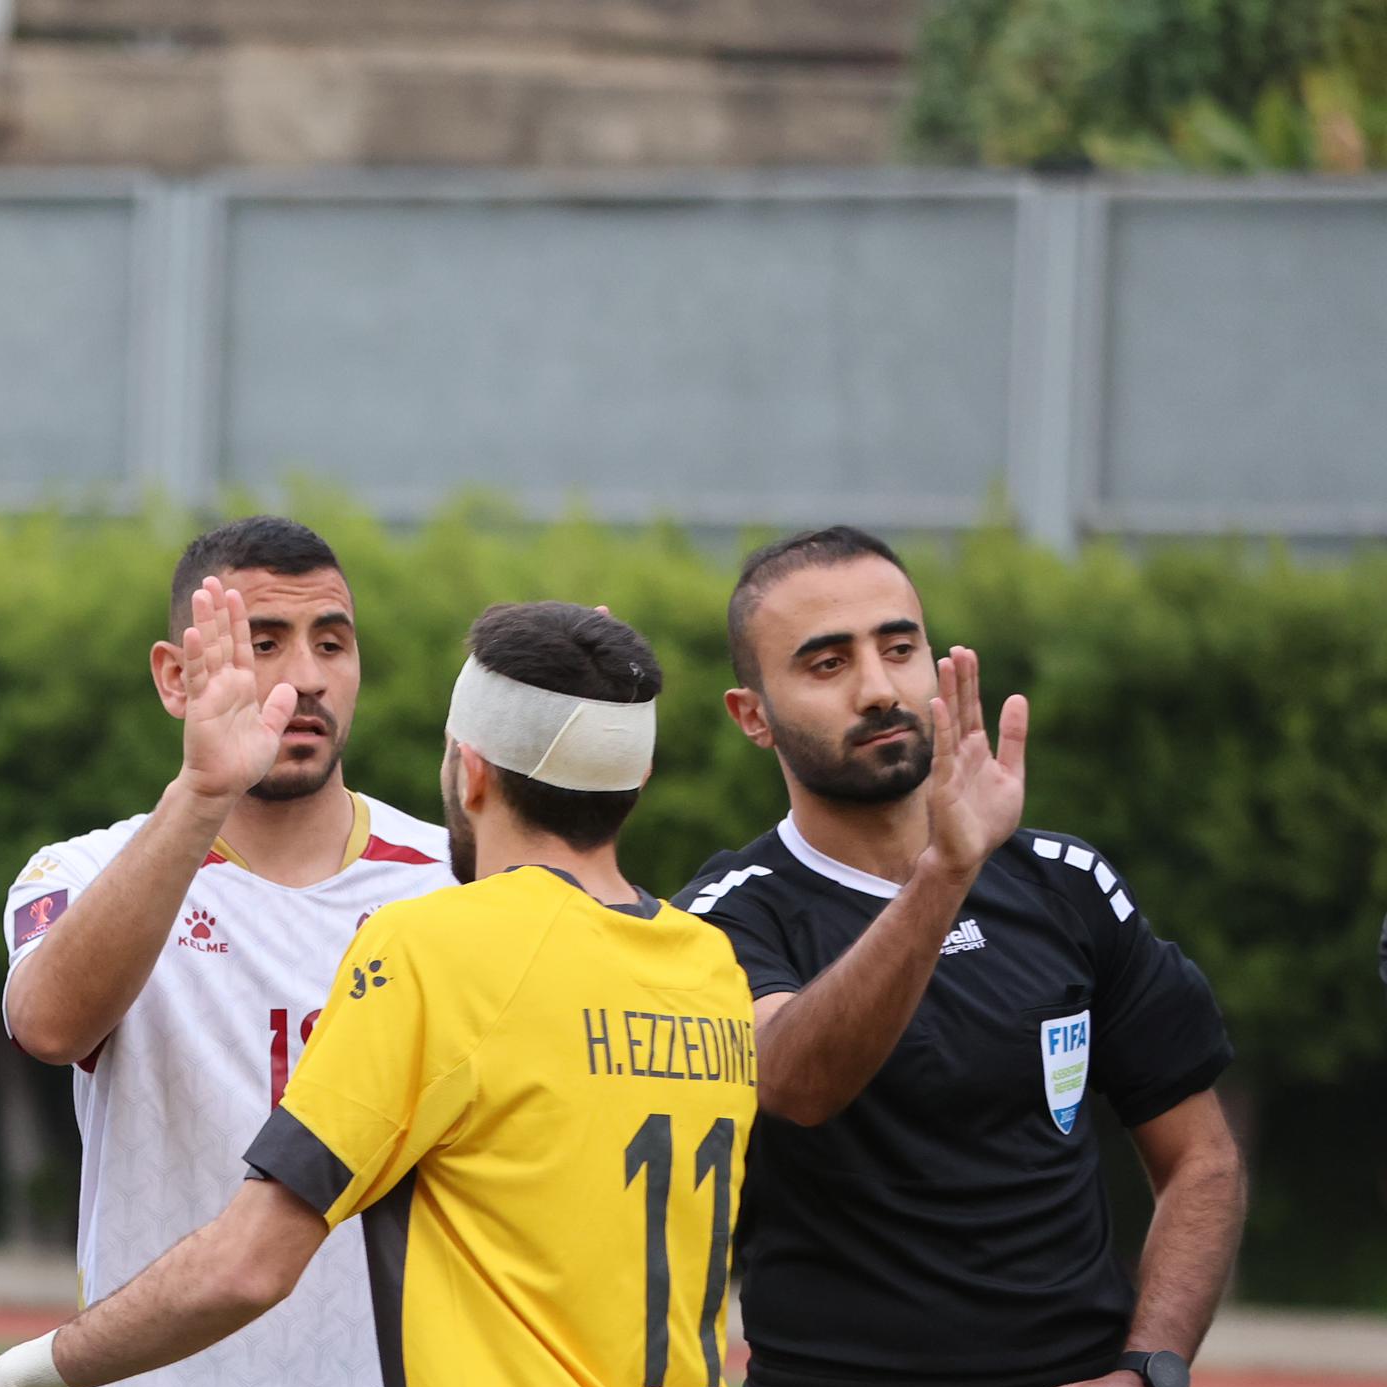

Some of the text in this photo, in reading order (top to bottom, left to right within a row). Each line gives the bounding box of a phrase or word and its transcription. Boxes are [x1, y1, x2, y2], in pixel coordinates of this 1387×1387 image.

[177, 935, 229, 953] KELME
[583, 1007, 756, 1087] H.EZZEDINE
[1047, 1020, 1087, 1056] FIFA
